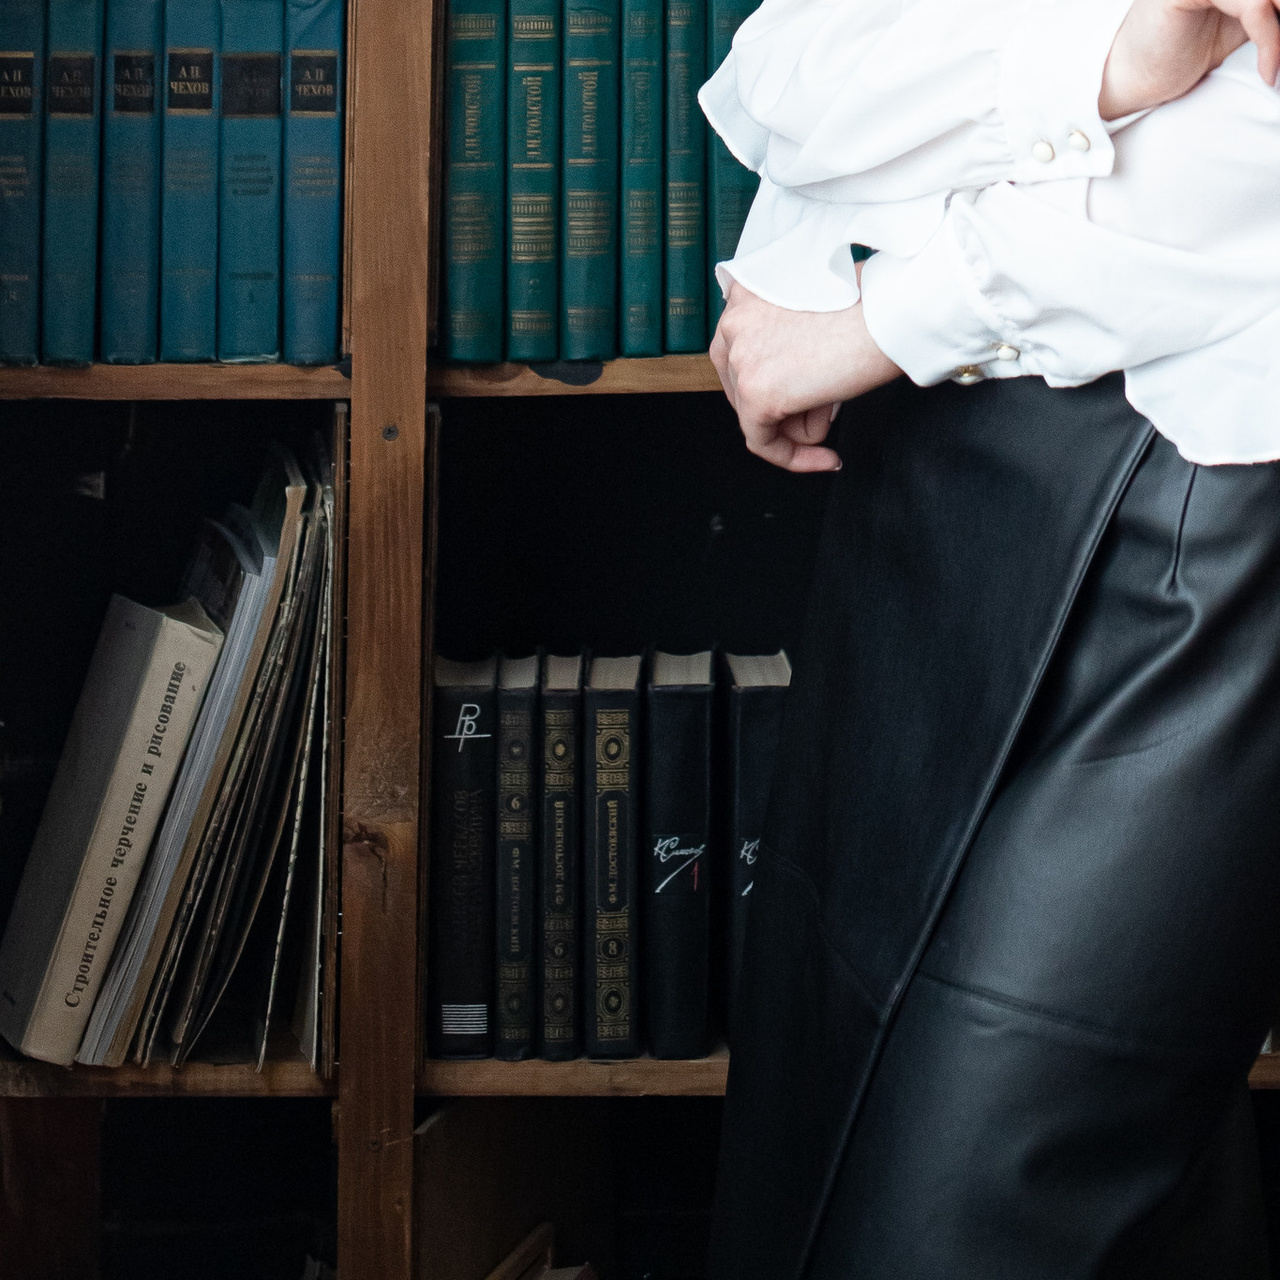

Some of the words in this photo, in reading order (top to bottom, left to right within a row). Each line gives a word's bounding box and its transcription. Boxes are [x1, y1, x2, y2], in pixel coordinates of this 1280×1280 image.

[169, 80, 210, 95] ЧЕХОВ
[295, 83, 334, 97] ЧЕХОВ
[63, 876, 118, 1009] Строительное
[106, 782, 149, 870] черчение
[146, 662, 188, 759] рисование
[605, 800, 618, 879] ДОСТОЕВСКИЙ
